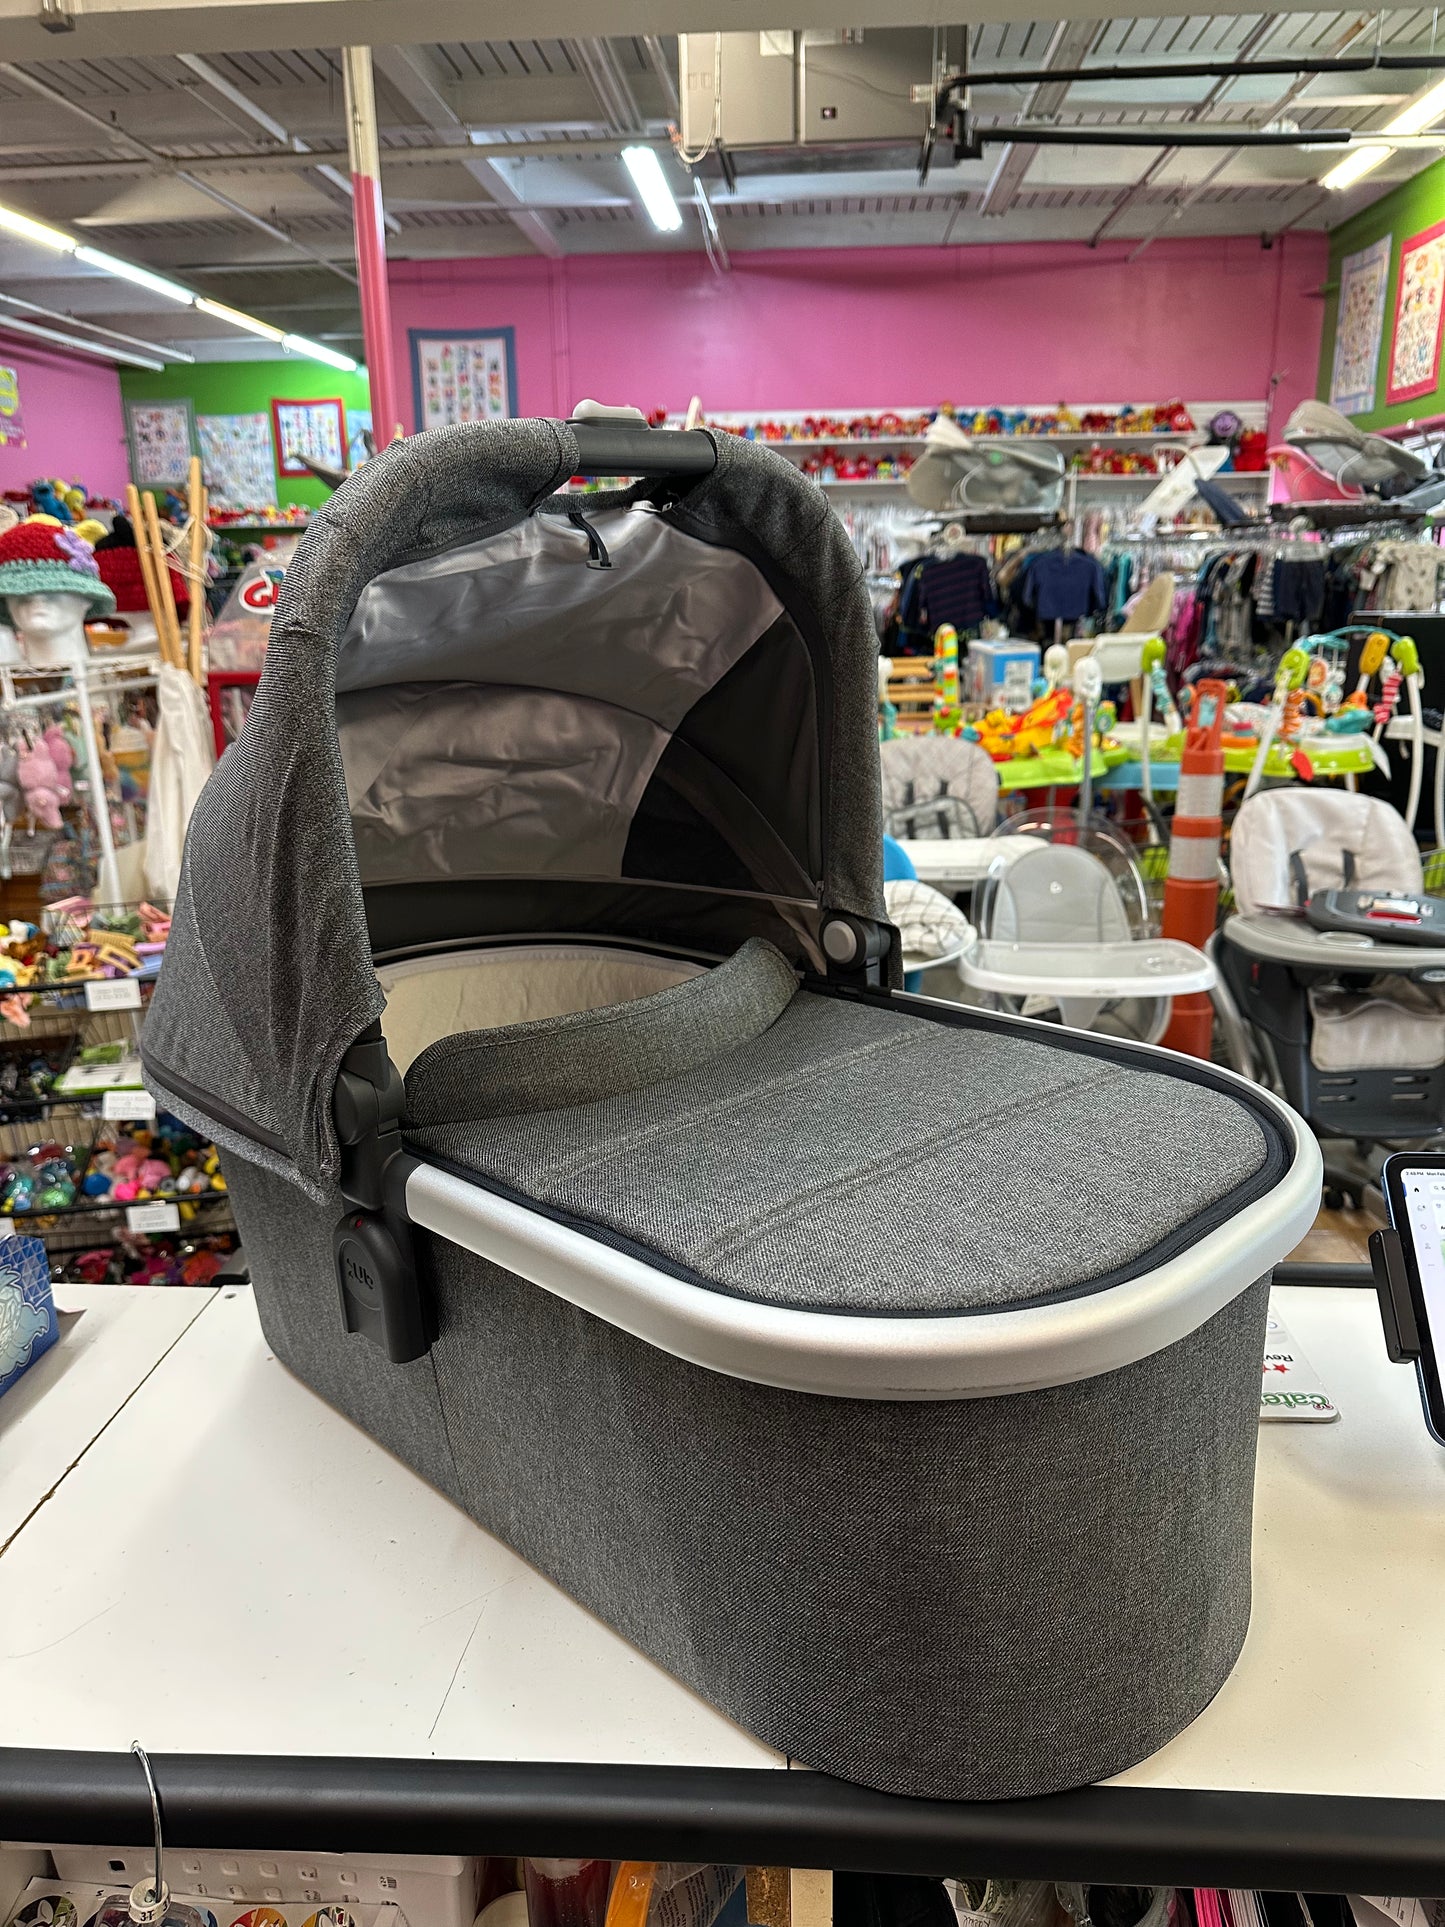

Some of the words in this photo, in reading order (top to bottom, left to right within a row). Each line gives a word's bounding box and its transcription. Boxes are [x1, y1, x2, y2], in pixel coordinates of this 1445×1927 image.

[1265, 1354, 1294, 1362] Rev
[1261, 1392, 1329, 1408] cate
[140, 1910, 154, 1922] 3T
